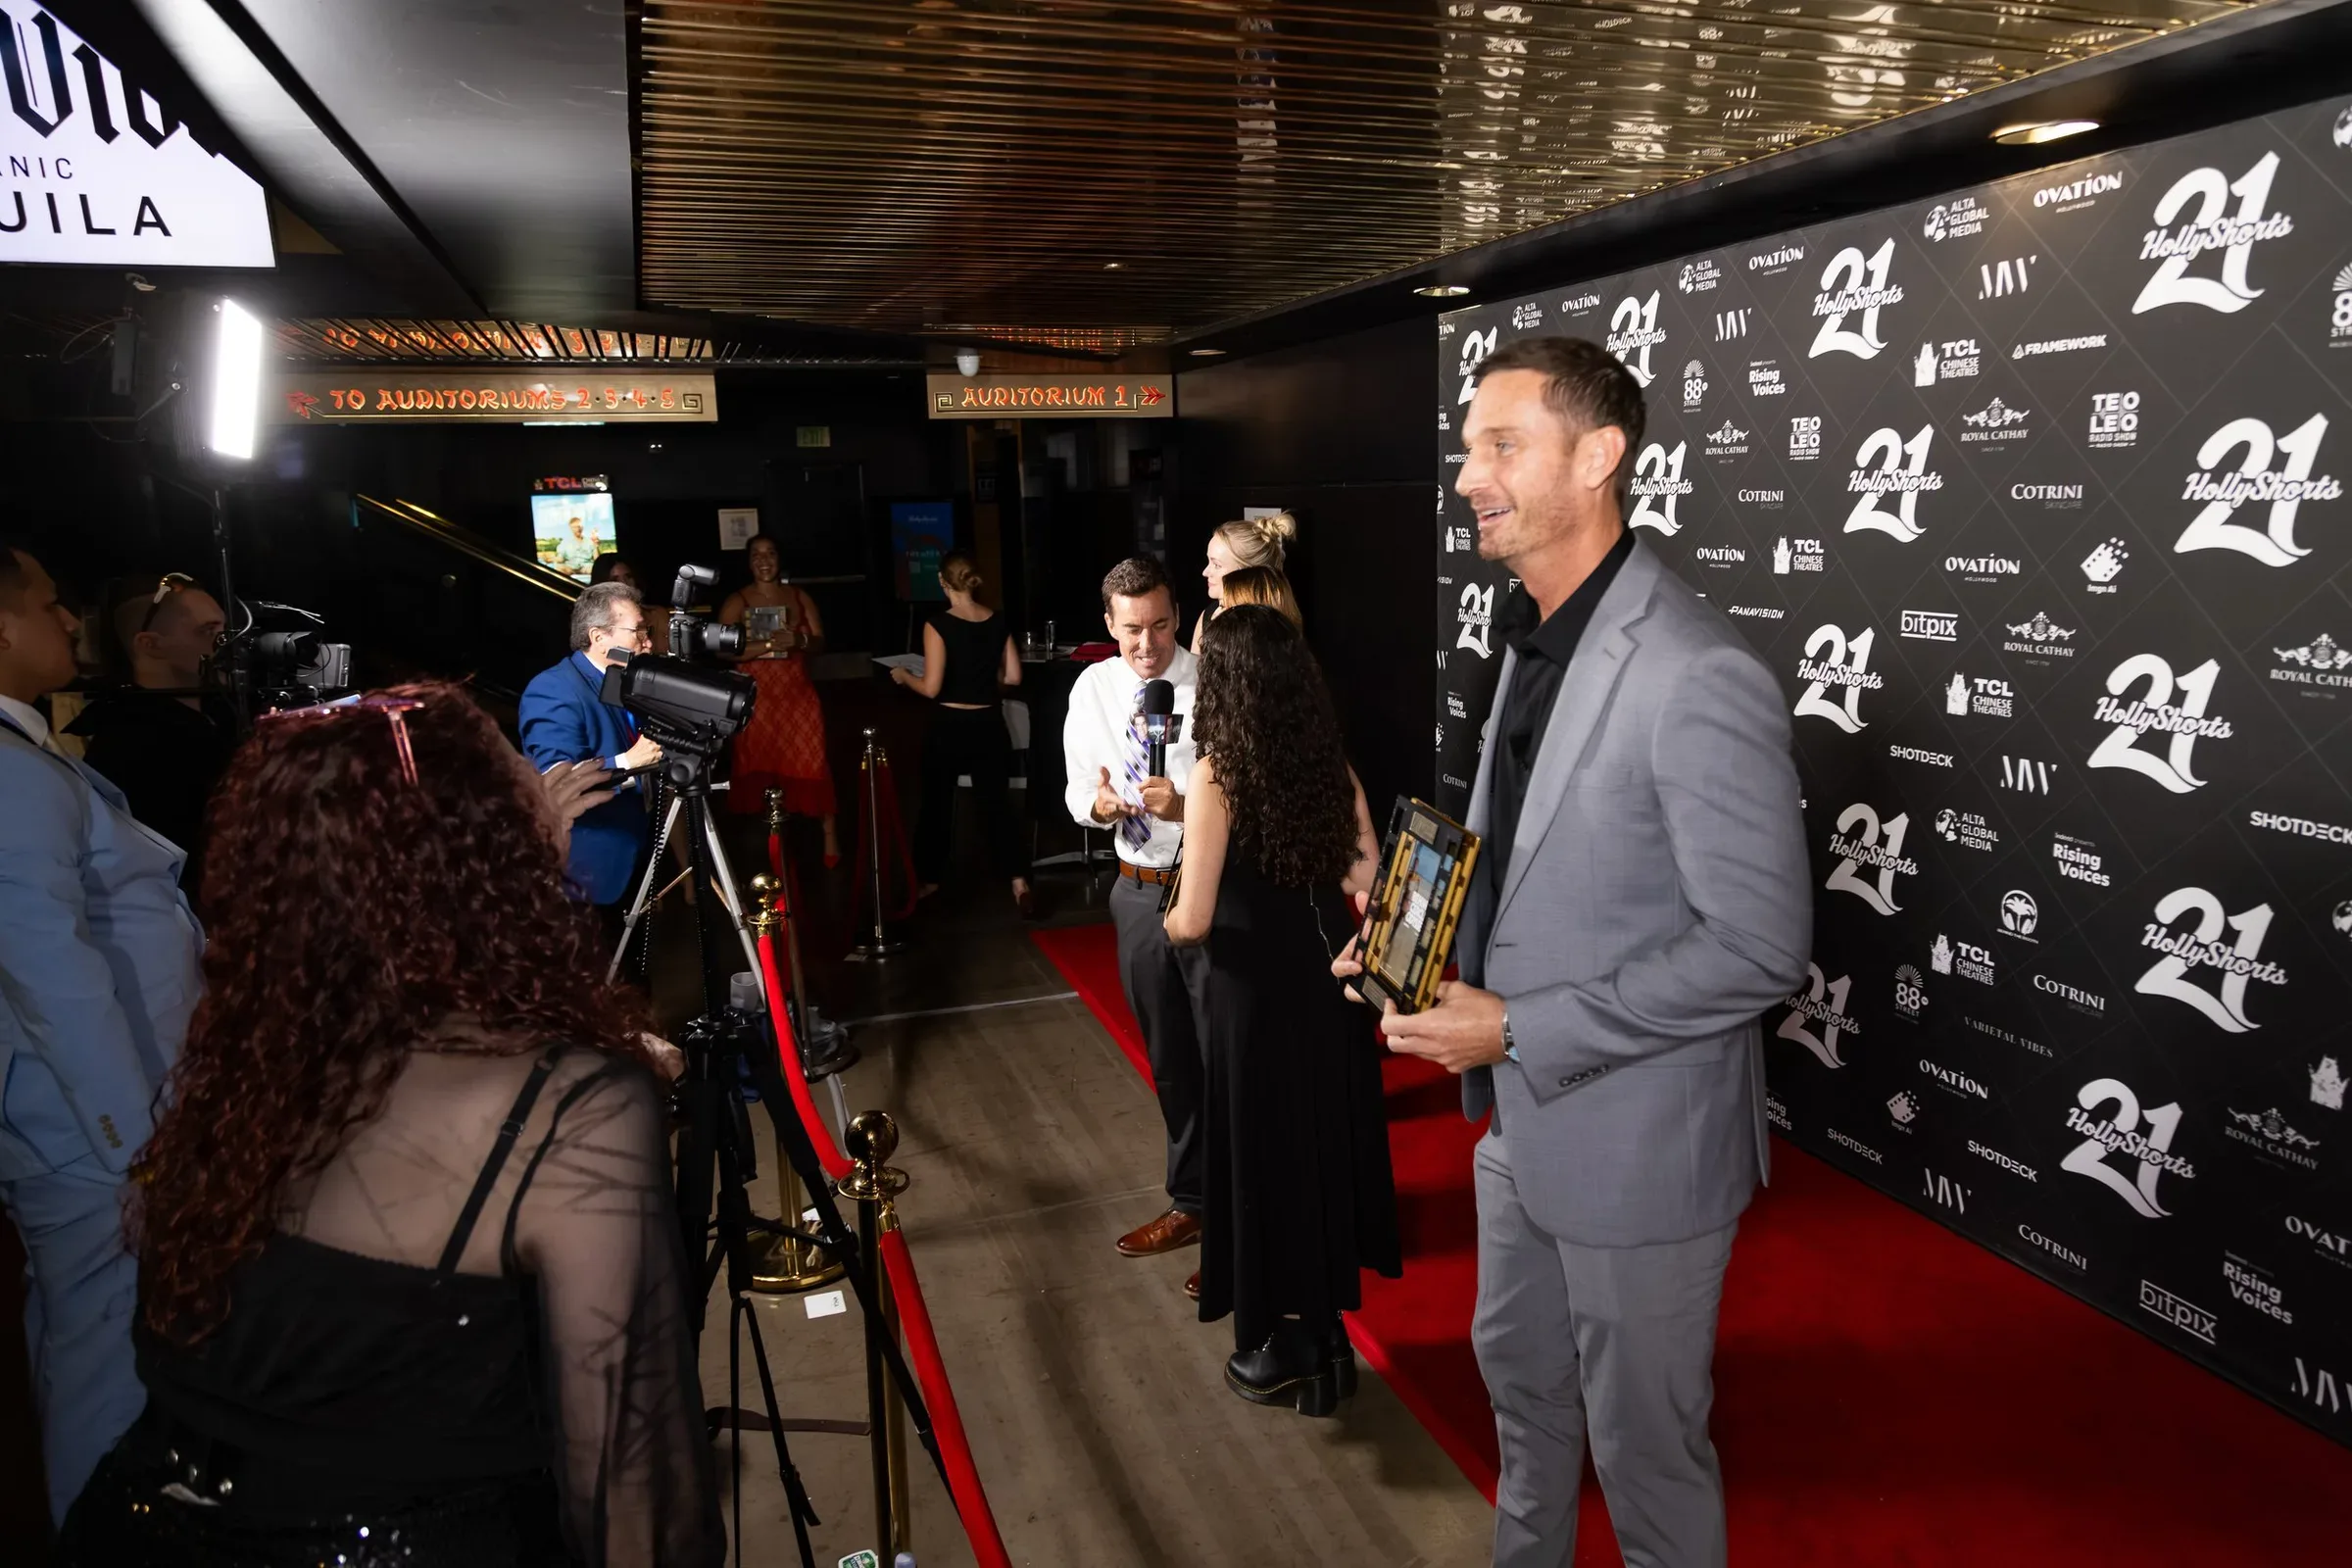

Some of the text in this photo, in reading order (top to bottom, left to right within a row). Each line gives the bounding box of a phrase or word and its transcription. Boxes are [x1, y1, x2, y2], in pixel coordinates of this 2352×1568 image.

[0, 156, 73, 179] NIC
[2034, 171, 2123, 208] OVATION
[1950, 197, 1976, 214] ALTA
[1950, 207, 1989, 226] GLOBAL
[1949, 223, 1983, 239] MEDIA
[2132, 150, 2280, 315] 21
[2139, 212, 2294, 261] HollyShorts
[1695, 260, 1712, 270] ALTA
[1748, 245, 1804, 270] OVATION
[1695, 268, 1721, 280] GLOBAL
[1695, 280, 1717, 292] MEDIA
[1525, 302, 1537, 312] ALTA
[1562, 293, 1600, 313] OVATION
[1808, 237, 1895, 360] 21
[1812, 284, 1904, 318] HollyShorts
[1524, 309, 1543, 320] GLOBAL
[1525, 319, 1540, 329] MEDIA
[1606, 326, 1667, 354] HollyShorts
[1610, 290, 1661, 389] 21
[1941, 338, 1981, 357] TCL
[2025, 334, 2107, 357] FRAMEWORK
[1940, 358, 1980, 371] CHINESE
[1940, 367, 1980, 379] THEATRES
[1749, 368, 1780, 384] Rising
[330, 388, 366, 411] TO
[376, 388, 567, 412] AUDITORIUMS
[961, 385, 1128, 407] AUDITORIUM 1
[1752, 382, 1786, 397] Voices
[1684, 398, 1702, 407] STREET
[2089, 413, 2138, 434] LEO
[1789, 432, 1821, 448] LEO
[1961, 427, 2029, 442] ROYAL CATHAY
[2088, 431, 2137, 443] RADIO SHOW
[1705, 445, 1749, 456] ROYAL CATHAY
[1789, 448, 1804, 457] RADIO
[544, 477, 582, 489] TCL
[1628, 440, 1688, 537] 21
[1630, 476, 1693, 500] HollyShorts
[1843, 423, 1935, 543] 21
[1847, 468, 1943, 498] HollyShorts
[2011, 483, 2083, 501] COTRINI
[2174, 412, 2329, 567] 21
[2181, 470, 2343, 508] HollyShorts
[1739, 489, 1784, 503] COTRINI
[1455, 527, 1471, 538] TCL
[1696, 545, 1745, 563] OVATION
[1793, 539, 1824, 553] TCL
[1793, 555, 1824, 564] CHINESE
[1793, 563, 1823, 571] THEATRES
[1945, 554, 2021, 574] OVATION
[1456, 582, 1494, 660] 21
[1728, 606, 1785, 619] PANAVISION
[1902, 613, 1957, 639] bitpix
[2004, 642, 2075, 658] ROYAL CATHAY
[1793, 623, 1875, 734] 21
[1797, 659, 1884, 690] HollyShorts
[2270, 668, 2314, 684] ROYAL
[1974, 678, 2014, 698] TCL
[1447, 697, 1464, 710] Rising
[1449, 707, 1467, 718] Voices
[1973, 695, 2013, 710] CHINESE
[1973, 704, 2013, 718] THEATRES
[2086, 653, 2221, 794] 21
[2093, 696, 2233, 739] HollyShorts
[1889, 745, 1953, 768] SHOTDECK
[1961, 812, 1985, 826] ALTA
[1961, 823, 1999, 842] GLOBAL
[1961, 835, 1992, 852] MEDIA
[1825, 803, 1909, 916] 21
[1829, 833, 1919, 876] HollyShorts
[2053, 843, 2101, 870] Rising
[2059, 859, 2110, 887] Voices
[1957, 941, 1995, 967] TCL
[2134, 887, 2275, 1033] 21
[2141, 923, 2288, 985] HollyShorts
[1956, 957, 1994, 978] CHINESE
[1956, 966, 1994, 986] THEATRES
[2033, 974, 2105, 1011] COTRINI
[1776, 961, 1851, 1069] 21
[1894, 1003, 1920, 1017] STREET
[1964, 1015, 2054, 1058] VARIETAL VIBES
[1919, 1058, 1988, 1100] OVATION
[1827, 1128, 1883, 1165] SHOTDECK
[2060, 1078, 2183, 1218] 21
[2066, 1106, 2196, 1179] HollyShorts
[2225, 1126, 2263, 1151] ROYAL
[2266, 1142, 2319, 1170] CATHAY
[1967, 1140, 2037, 1183] SHOTDECK
[2019, 1224, 2087, 1271] COTRINI
[2223, 1260, 2282, 1304] Rising
[2230, 1282, 2293, 1325] Voices
